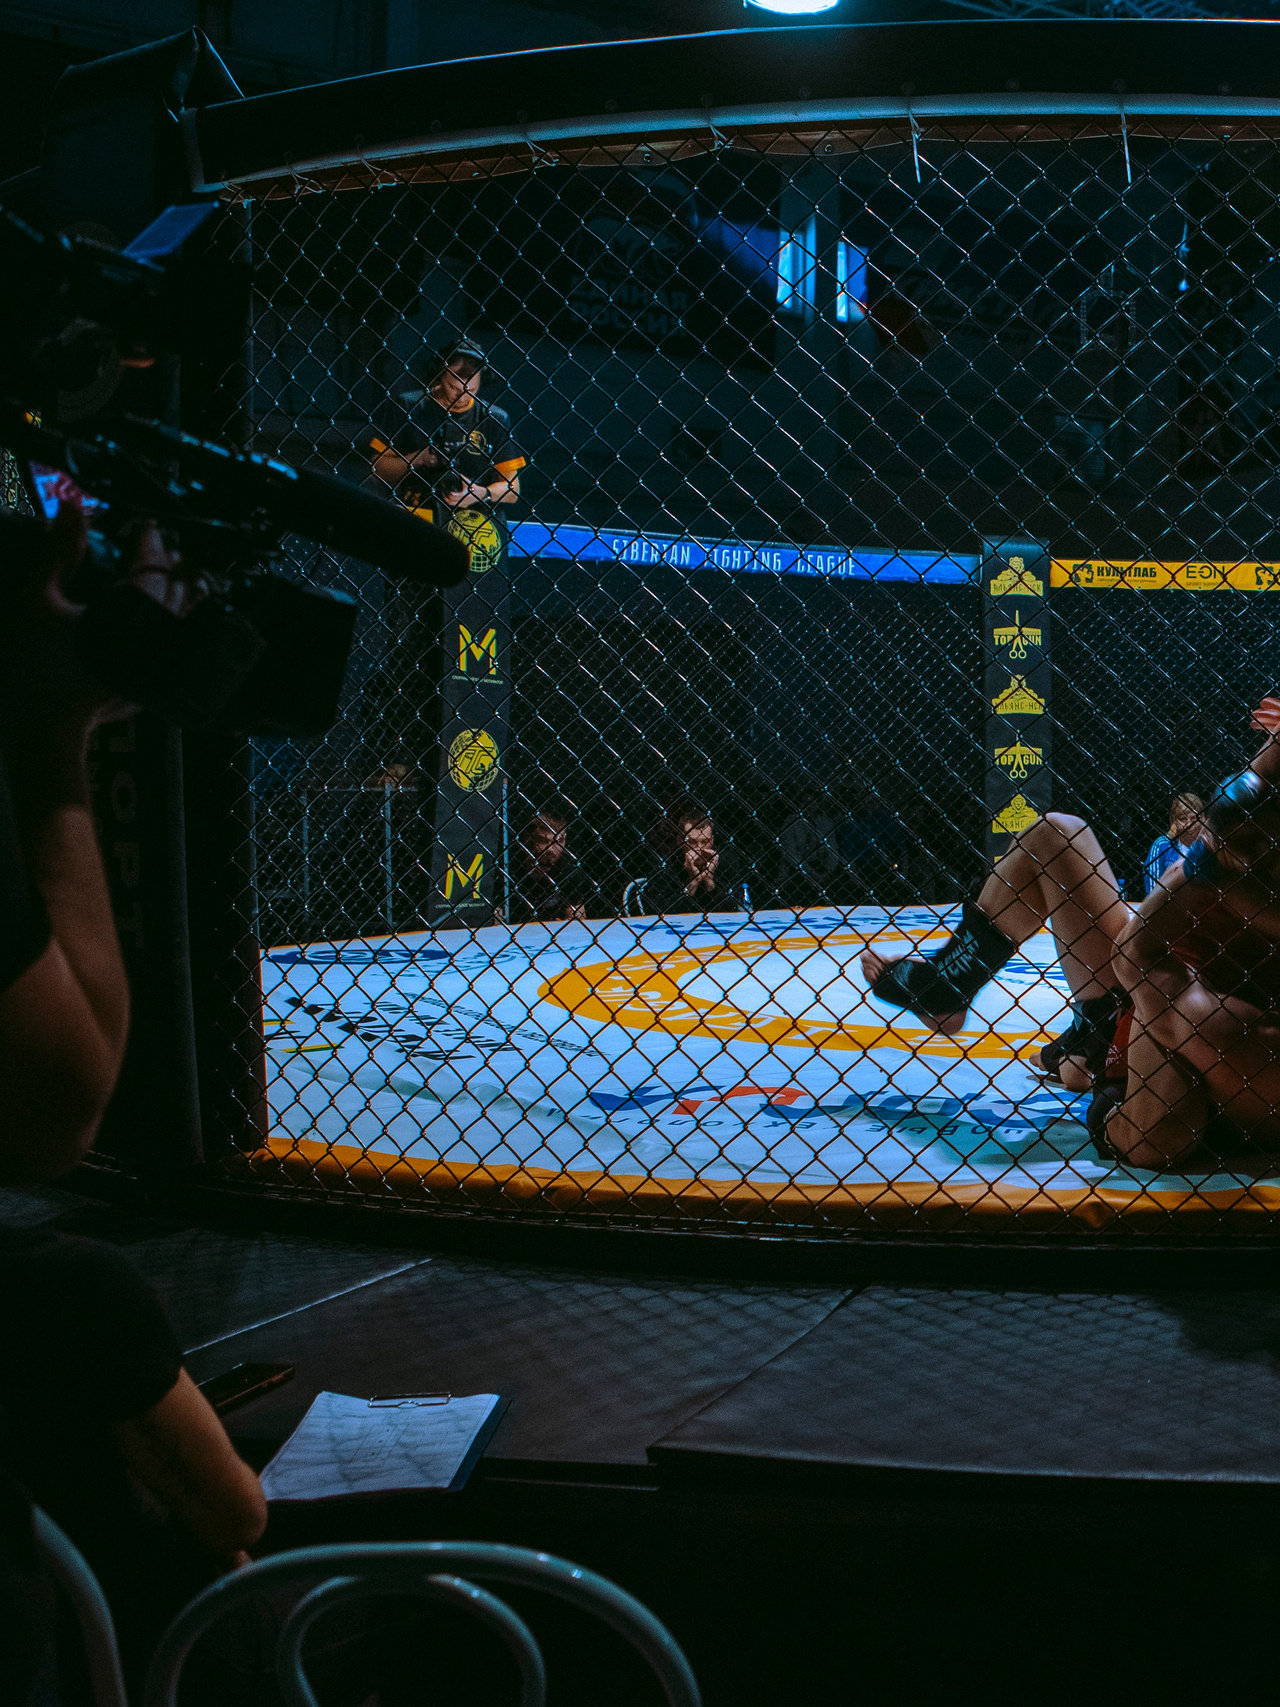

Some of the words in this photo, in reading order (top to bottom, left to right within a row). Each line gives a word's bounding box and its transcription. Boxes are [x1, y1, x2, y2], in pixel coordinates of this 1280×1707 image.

[612, 538, 690, 566] SIBERIAN
[705, 548, 782, 572] FIGHTING
[797, 553, 855, 576] LEAGUE
